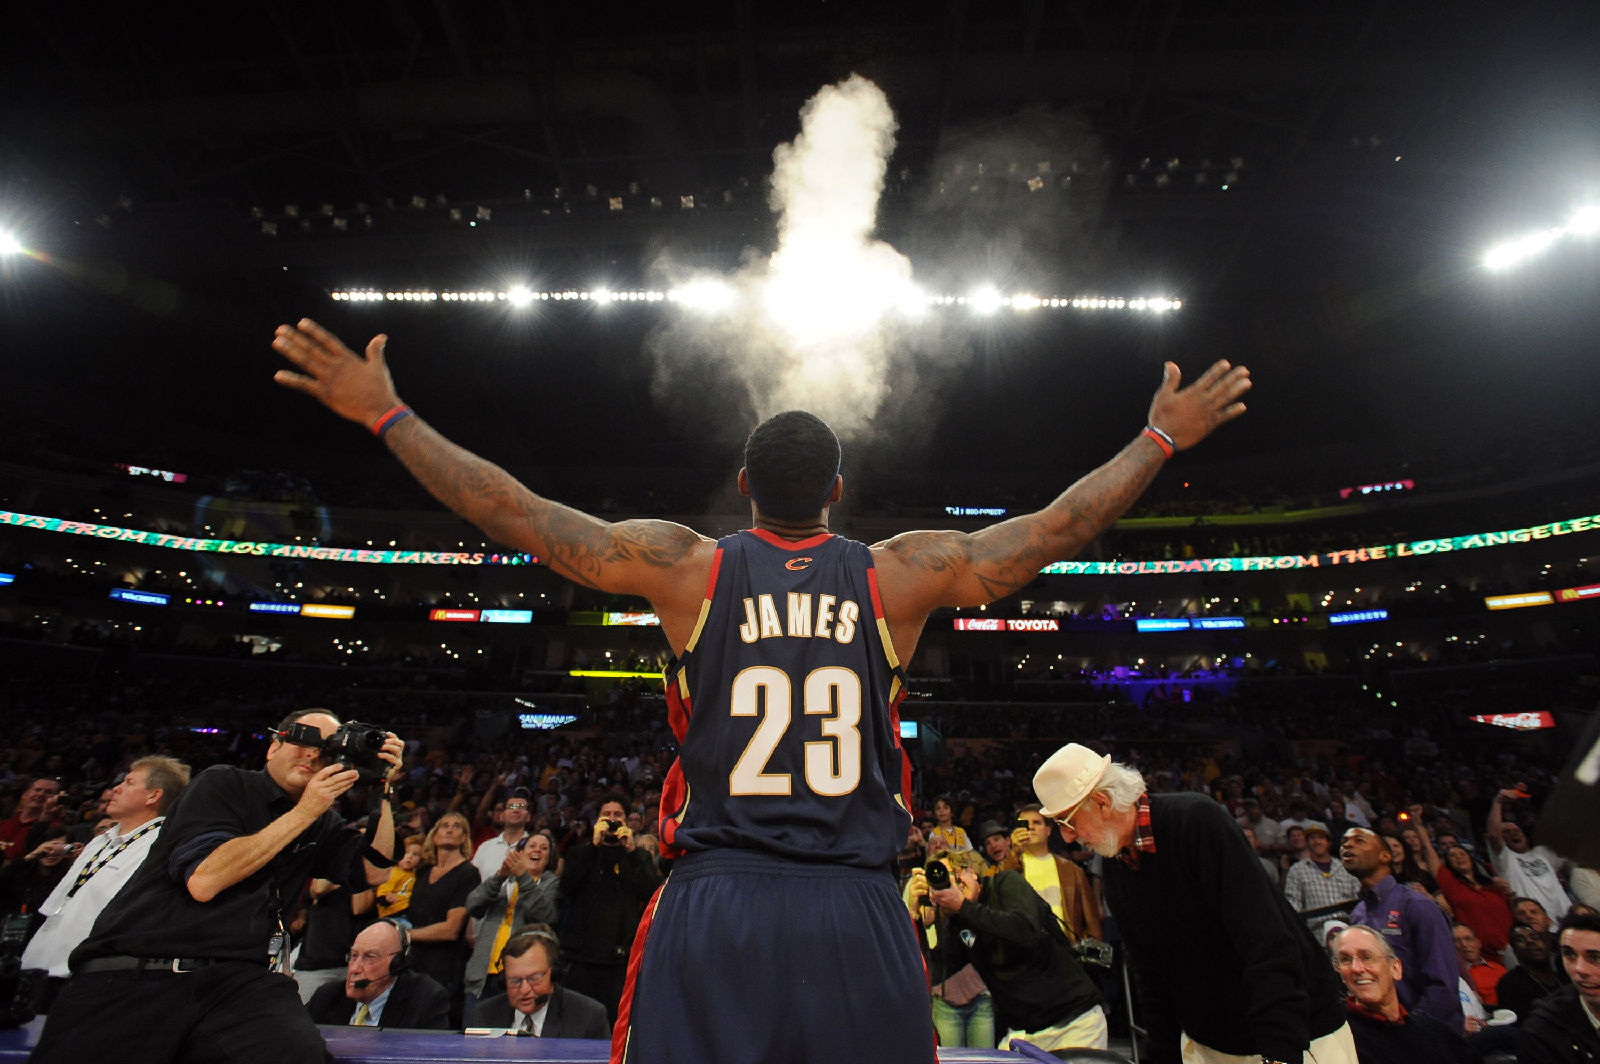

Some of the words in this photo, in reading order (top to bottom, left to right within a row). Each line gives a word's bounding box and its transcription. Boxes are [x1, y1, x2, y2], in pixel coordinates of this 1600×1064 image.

[57, 519, 148, 543] FROM
[156, 533, 212, 550] THE
[218, 540, 269, 556] LOS
[272, 545, 386, 563] ANGELES
[391, 551, 485, 565] LAKERS
[1098, 558, 1233, 574] HOLIDAYS
[1241, 555, 1320, 571] FROM
[1327, 546, 1387, 564] THE
[1397, 538, 1454, 557] LOS
[739, 592, 860, 644] JAMES
[1007, 620, 1059, 631] TOYOTA
[729, 665, 862, 797] 23
